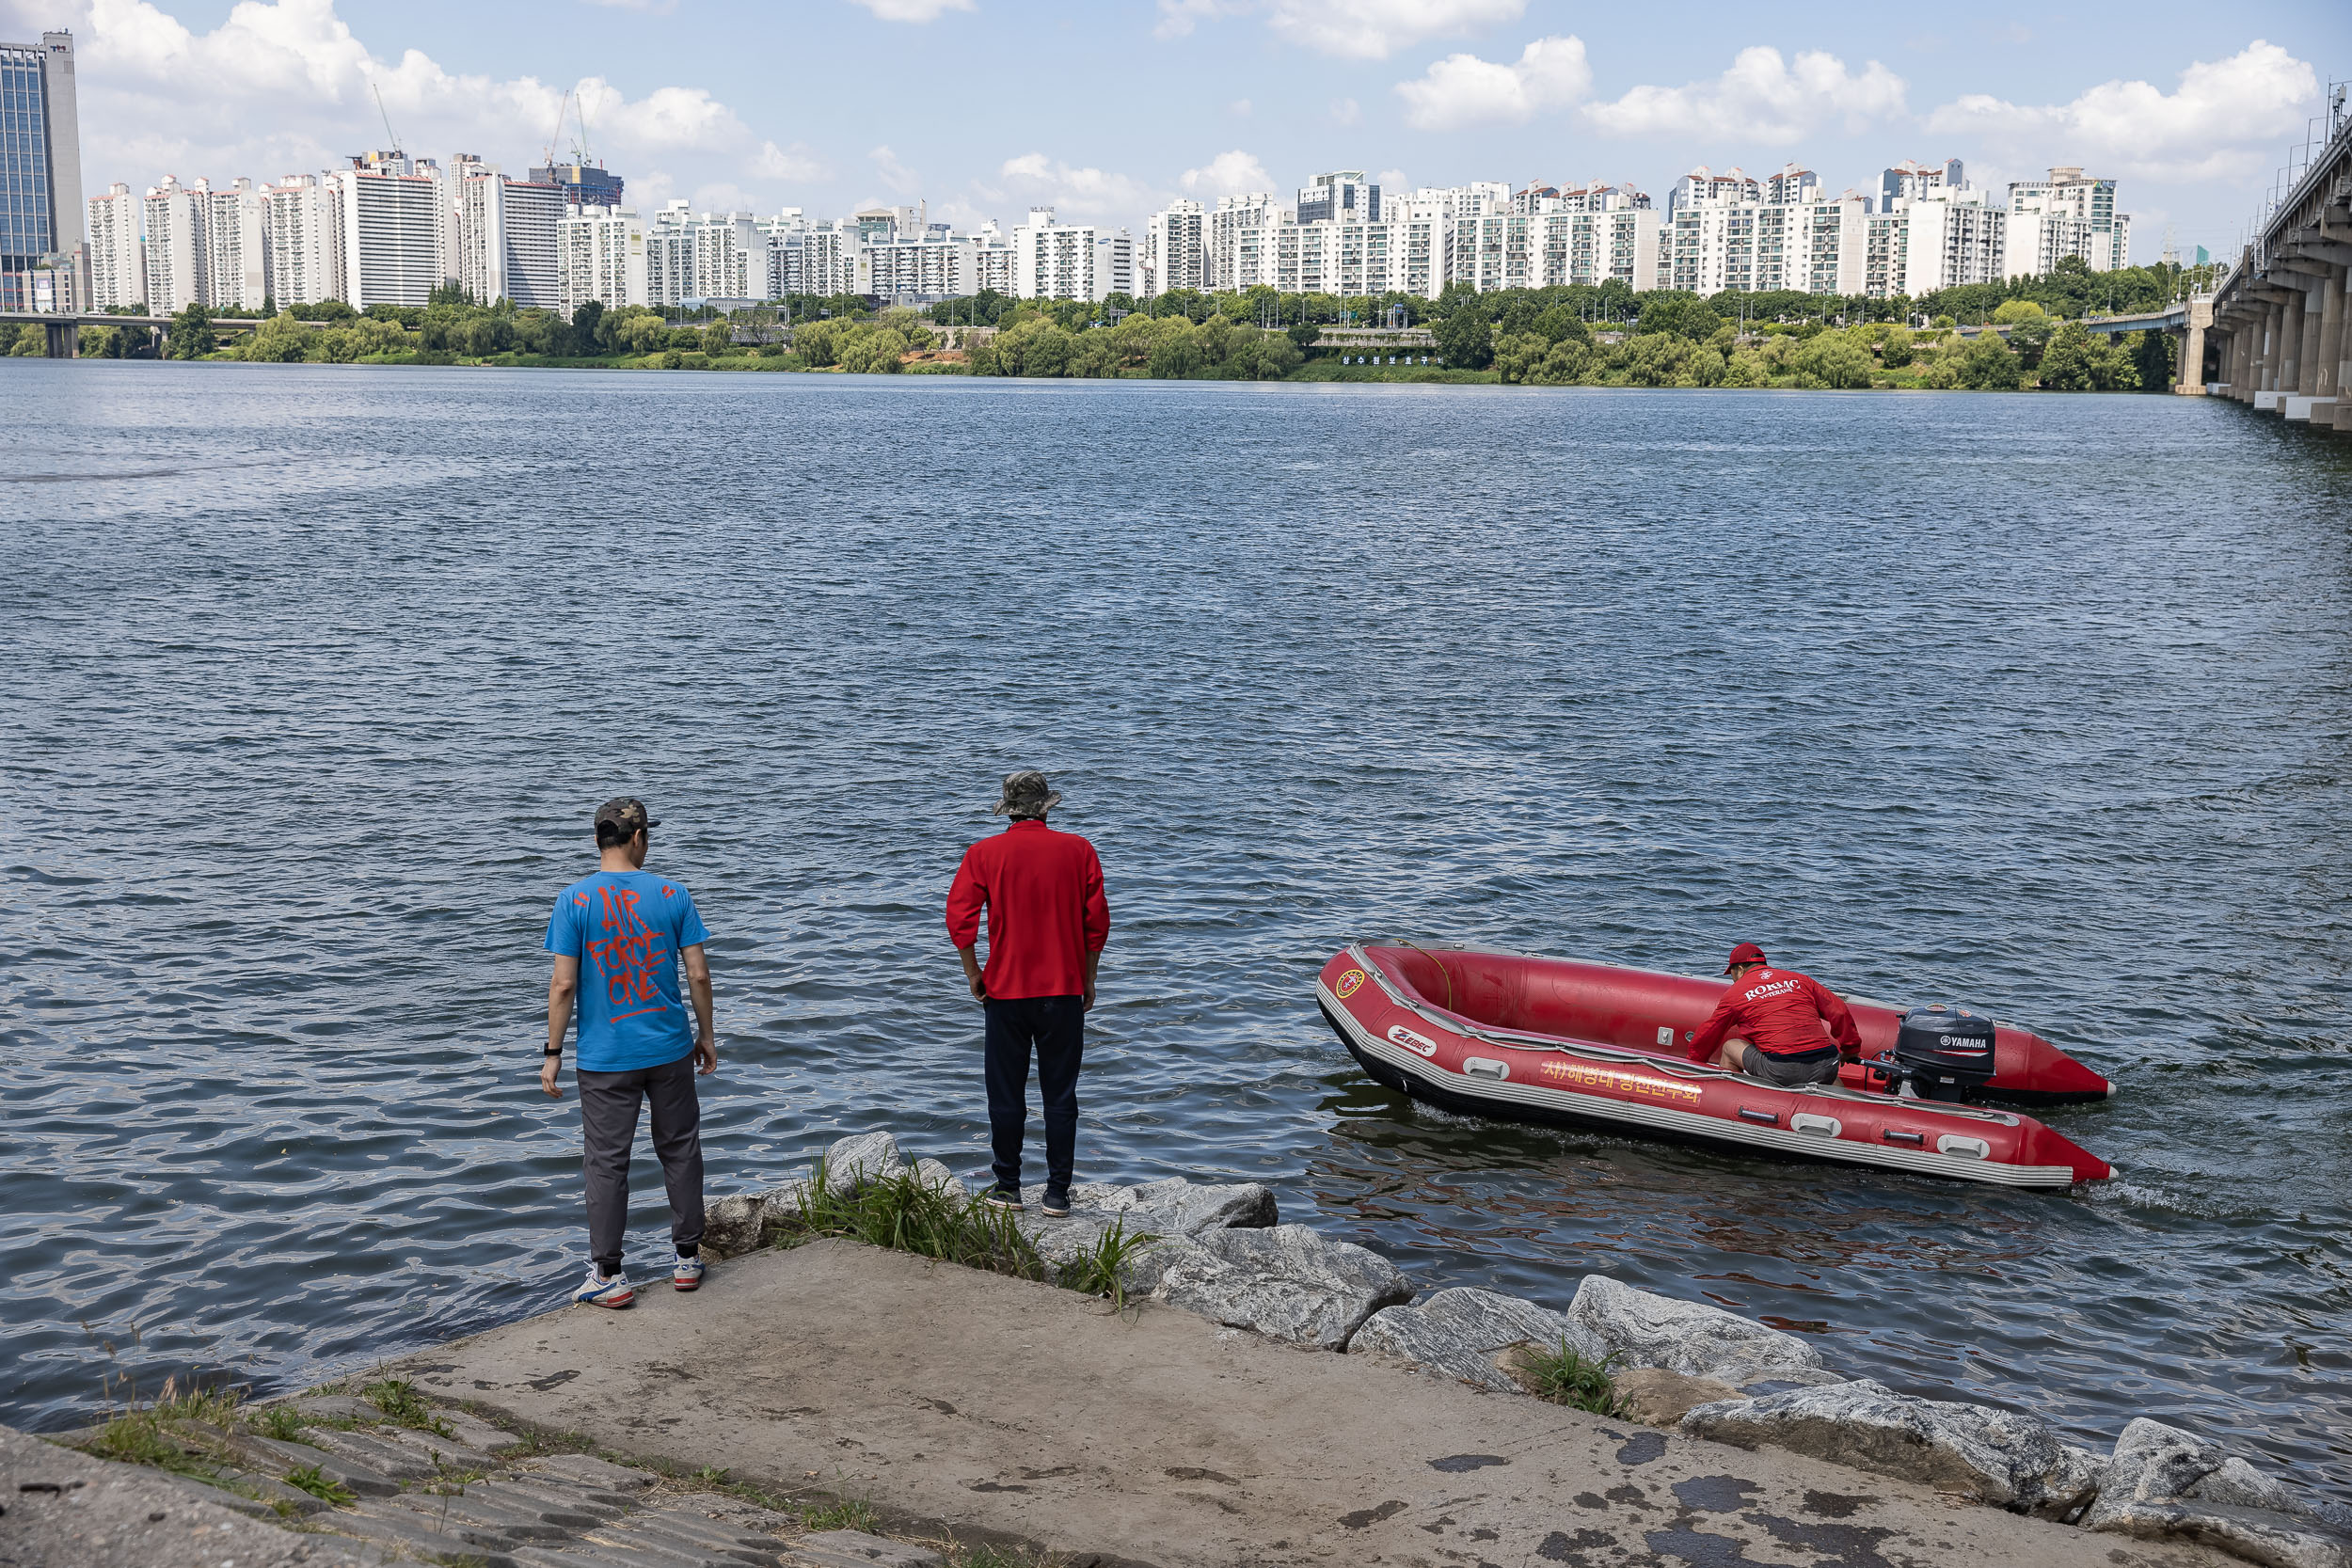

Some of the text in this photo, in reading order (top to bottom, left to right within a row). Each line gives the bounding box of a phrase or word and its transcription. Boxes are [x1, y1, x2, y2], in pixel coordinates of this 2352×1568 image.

[586, 932, 667, 976] FORCE
[609, 970, 660, 1006] ONE
[1744, 979, 1801, 1001] ROKMC
[1392, 1028, 1432, 1053] ZEBEC
[1951, 1037, 1986, 1048] YAMAHA
